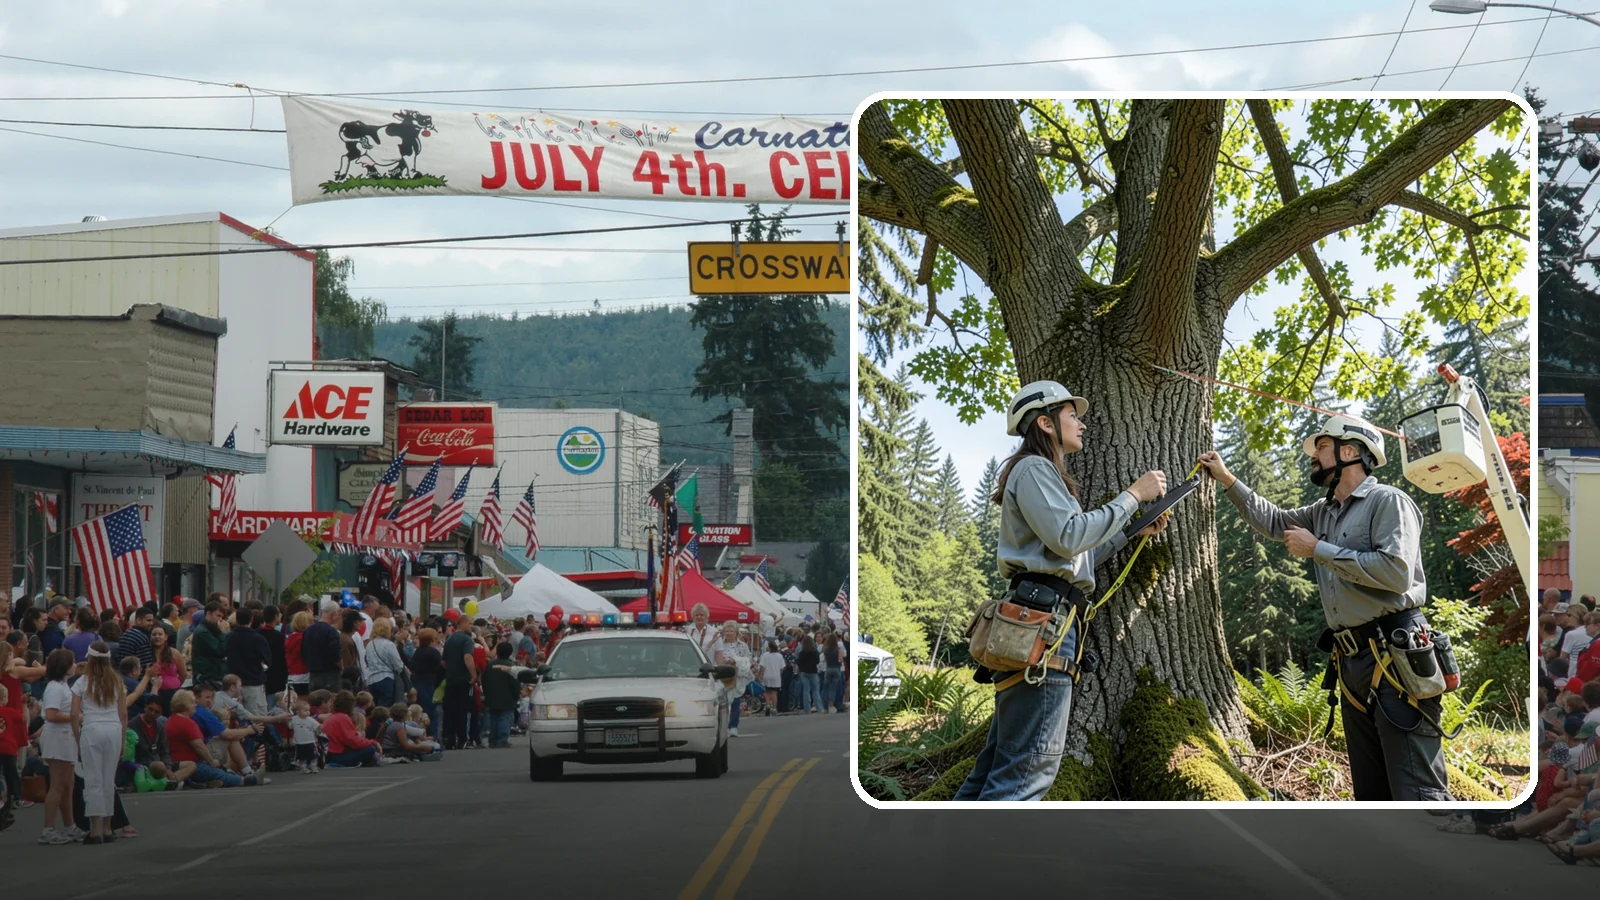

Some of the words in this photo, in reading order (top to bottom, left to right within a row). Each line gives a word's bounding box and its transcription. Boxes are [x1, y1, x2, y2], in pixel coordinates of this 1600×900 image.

[695, 122, 850, 149] Carnat
[481, 140, 605, 192] JULY
[632, 150, 746, 197] 4th.
[697, 254, 850, 280] CROSSWA
[283, 380, 373, 419] ACE
[406, 409, 452, 422] CEDAR
[283, 421, 371, 436] Hardware
[416, 428, 477, 447] Coca-Cola
[353, 467, 386, 480] Simpl
[83, 484, 94, 494] St.
[95, 485, 124, 495] Vincent
[126, 486, 136, 495] de
[137, 486, 155, 495] Paul
[213, 516, 330, 535] HARDARE
[688, 526, 741, 535] CRNATION
[699, 535, 730, 544] GLASS
